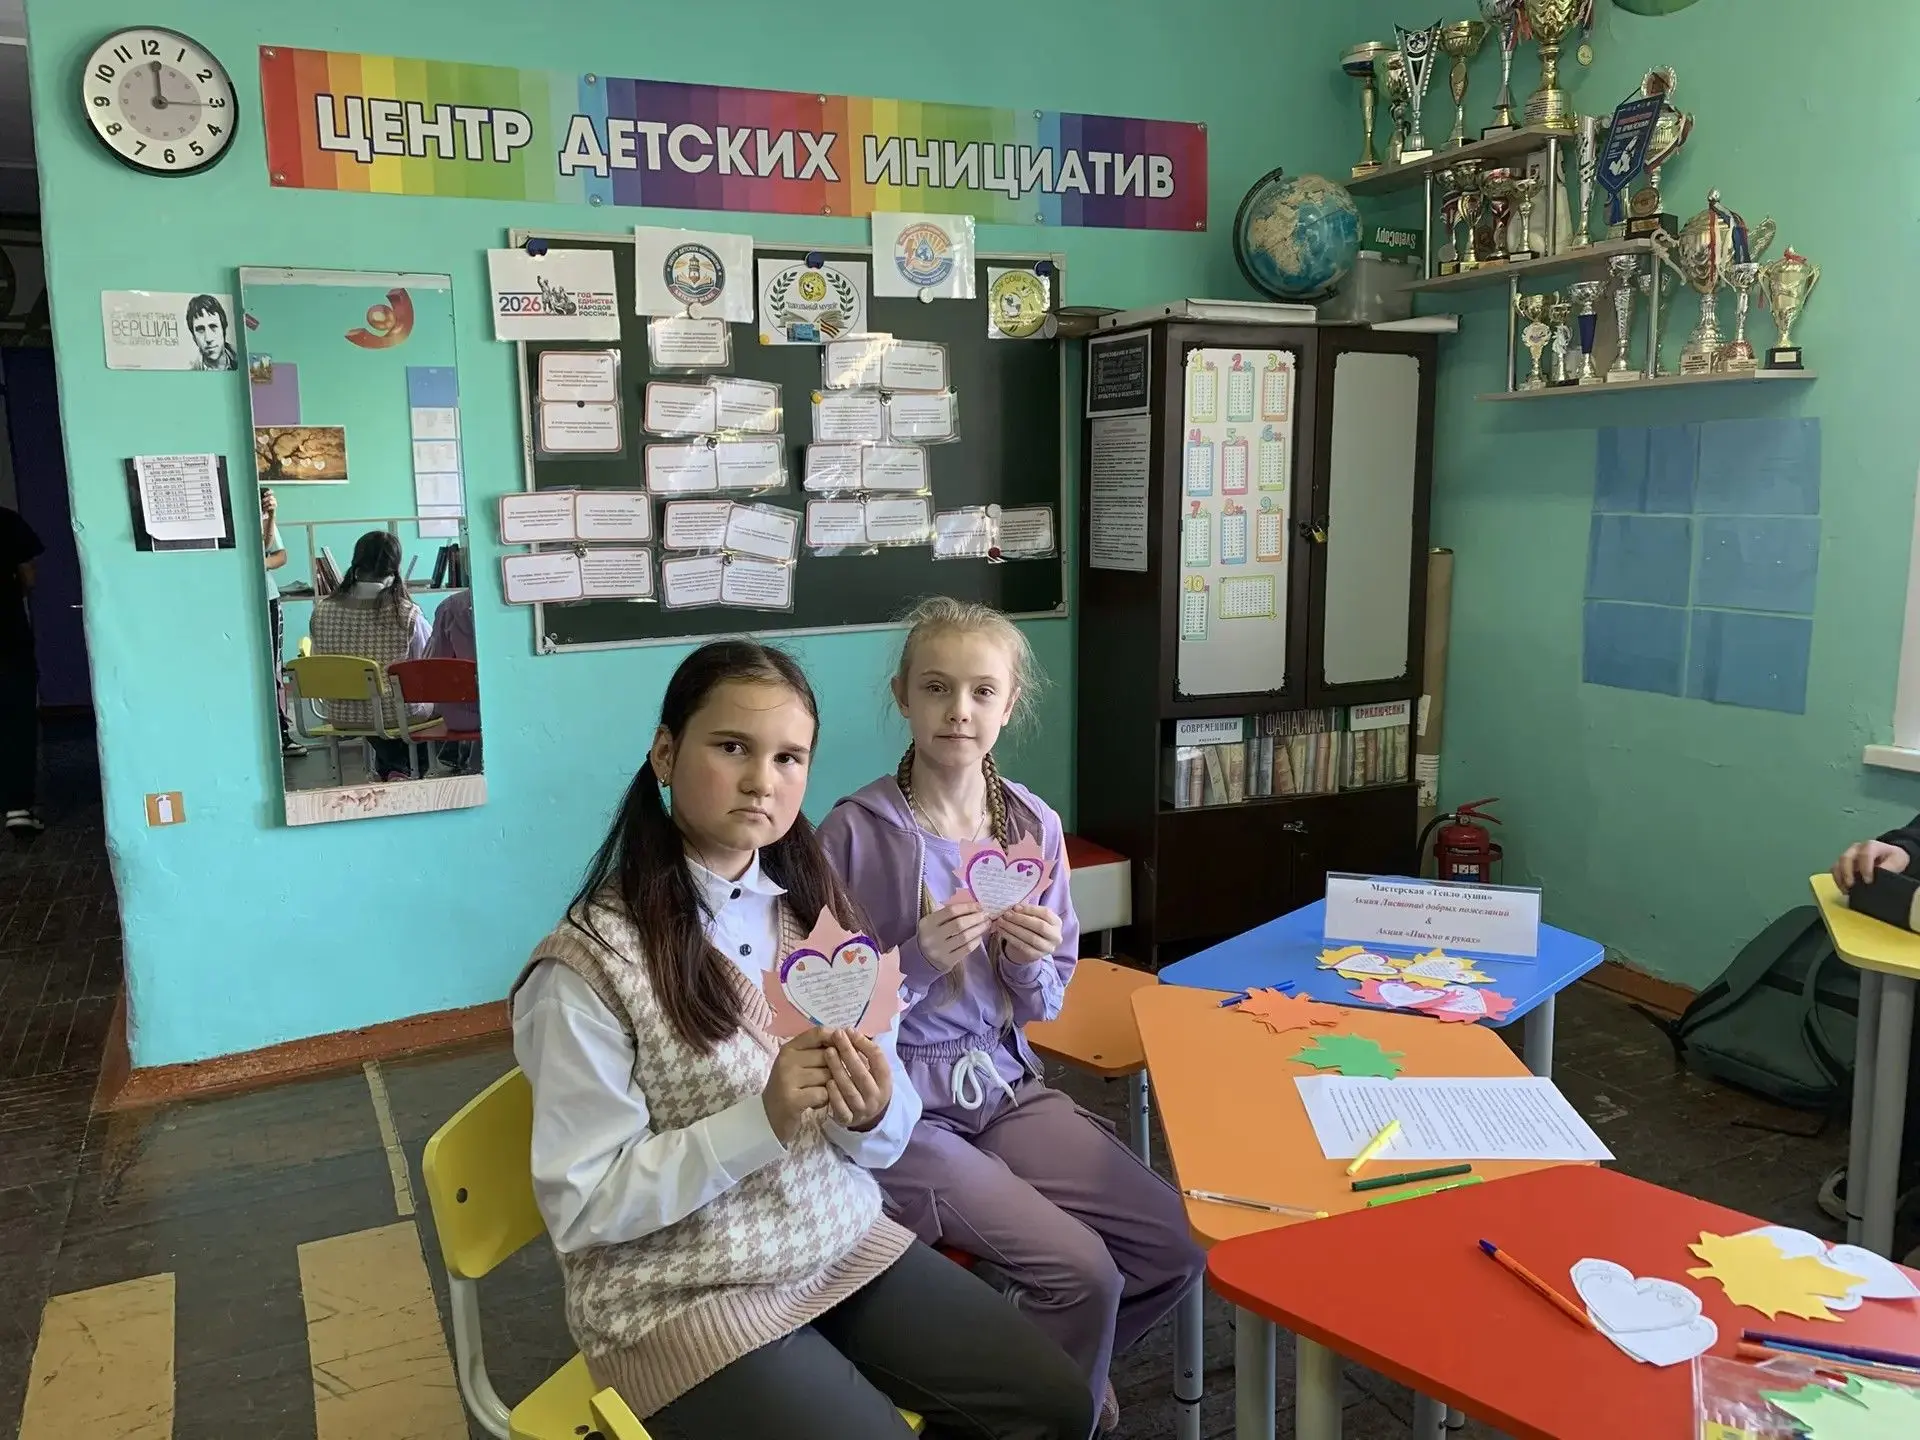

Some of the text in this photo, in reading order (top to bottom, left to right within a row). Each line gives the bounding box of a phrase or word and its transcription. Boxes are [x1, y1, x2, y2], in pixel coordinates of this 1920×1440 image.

[113, 45, 133, 64] 11
[141, 39, 160, 56] 12
[176, 48, 186, 62] 1
[95, 64, 115, 84] 10
[196, 68, 213, 83] 2
[93, 95, 111, 108] 9
[208, 97, 226, 108] 3
[105, 122, 123, 136] 8
[206, 123, 223, 137] 4
[134, 140, 147, 156] 7
[188, 140, 204, 157] 5
[314, 93, 1176, 200] ЦЕНТР ДЕТСКИХ ИНИЦИАТИВ
[163, 148, 176, 164] 6
[499, 296, 542, 312] 2026
[111, 319, 179, 337] ВЕРШИН
[1354, 703, 1405, 720] ПРИКЛЮЧЕНИЯ
[1180, 720, 1238, 735] СОВРЕМЕННИКИ
[1265, 709, 1326, 737] ФАНТАСТИКА
[1371, 883, 1493, 902] Мастерская «Тепло души»
[1353, 896, 1510, 917] Акция Листопад добрых пожеланий
[1425, 917, 1432, 925] &
[1376, 927, 1404, 938] Акция
[1404, 929, 1444, 940] «Письмо
[1450, 935, 1481, 945] руках»
